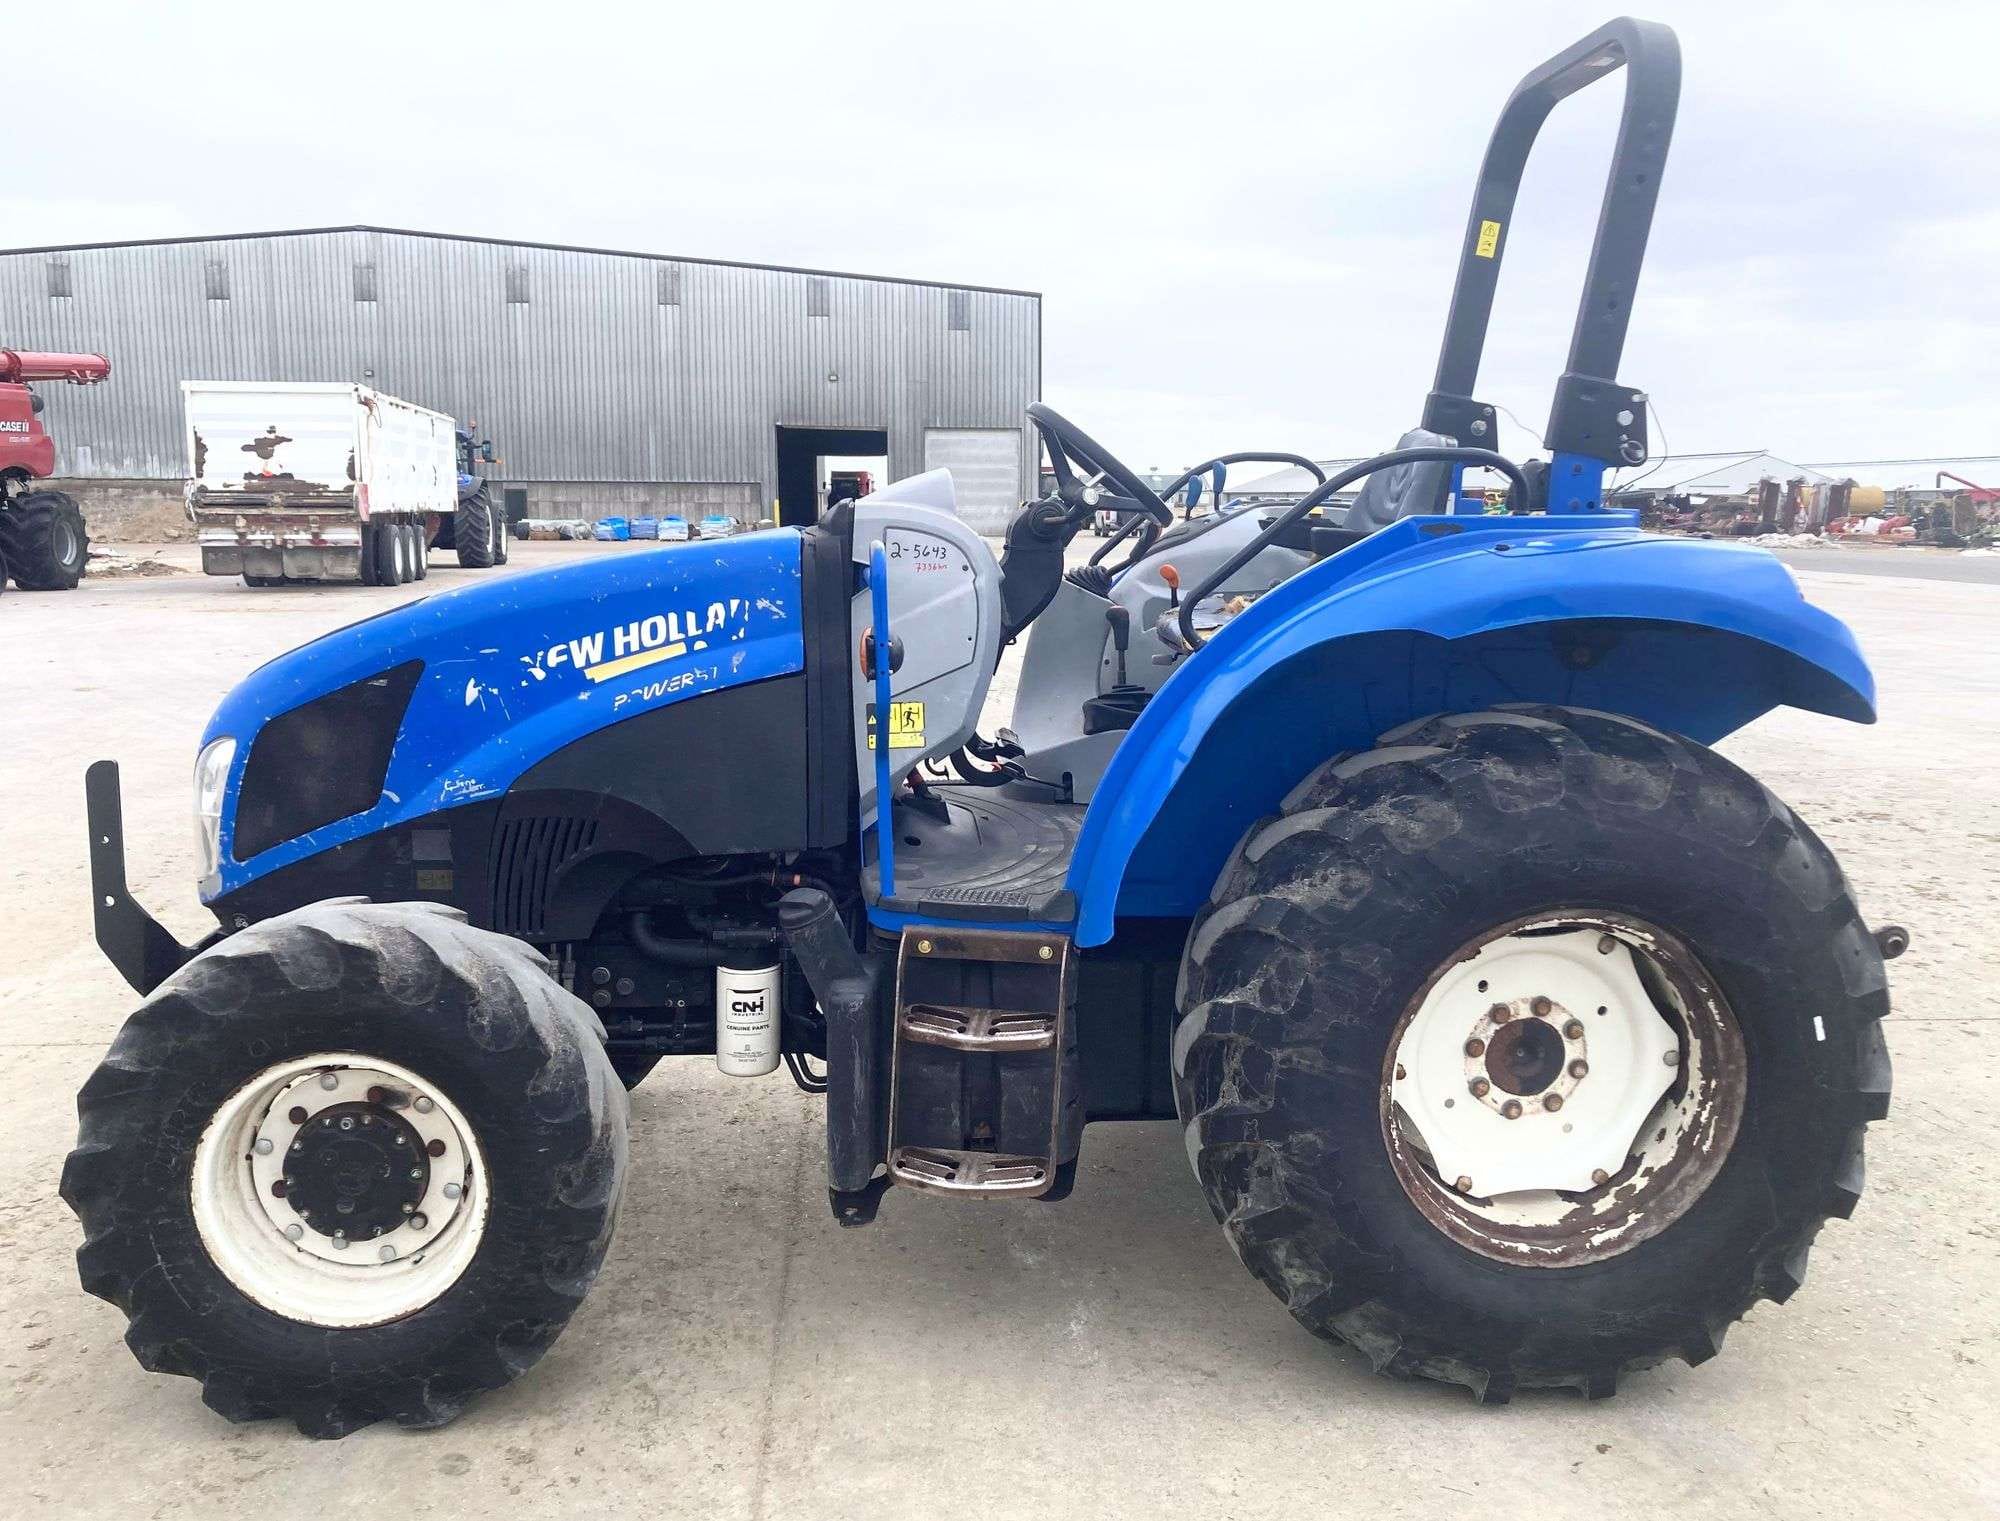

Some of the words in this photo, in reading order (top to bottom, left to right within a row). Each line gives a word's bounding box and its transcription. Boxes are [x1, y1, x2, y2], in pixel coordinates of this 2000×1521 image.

[0, 421, 21, 432] CASE
[890, 541, 947, 560] 2-5643
[752, 1023, 770, 1031] PARTS
